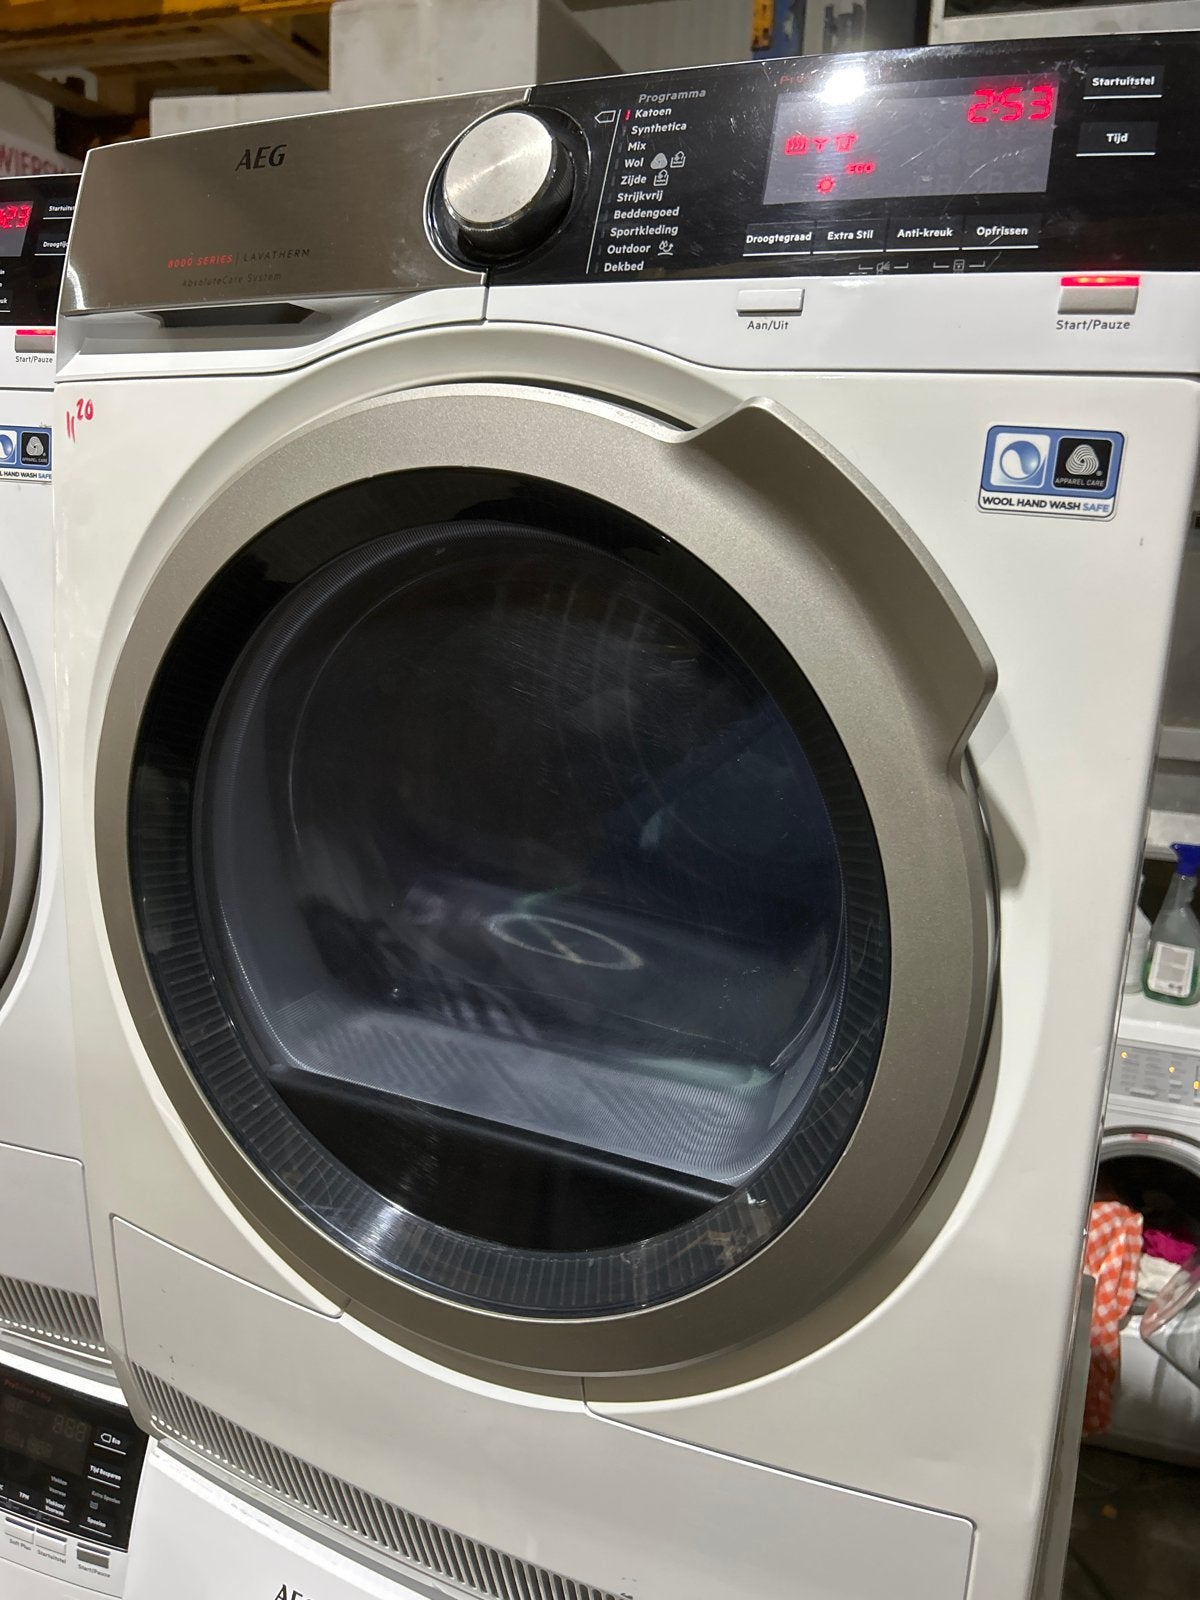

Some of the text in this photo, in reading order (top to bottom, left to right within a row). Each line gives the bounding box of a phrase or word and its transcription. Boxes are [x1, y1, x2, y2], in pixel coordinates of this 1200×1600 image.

[1092, 76, 1155, 87] Startuitstel
[638, 89, 706, 103] Programma
[968, 85, 1056, 124] 2:53
[635, 107, 672, 119] Katoen
[631, 122, 687, 136] Synthetica
[1106, 132, 1129, 144] Tijd
[627, 141, 647, 151] Mix
[234, 144, 287, 171] AEG
[624, 157, 645, 168] Wol
[620, 175, 647, 187] Zijde
[617, 190, 664, 203] Strijkvrij
[613, 206, 680, 220] Beddengoed
[610, 225, 679, 238] Sportkleding
[827, 229, 874, 241] Extra Stil
[897, 227, 953, 239] Anti-kreuk
[976, 225, 1029, 238] Opfrissen
[746, 231, 812, 245] Droogtegraad
[607, 244, 651, 255] Outdoor
[196, 255, 233, 266] SERIES
[244, 249, 310, 262] LAVATHERM
[603, 261, 645, 273] Dekbed
[182, 272, 282, 288] AbsoluteCare System
[747, 319, 789, 332] Aan/Uit
[1056, 319, 1131, 331] Start/Pauze
[15, 355, 53, 364] Start/Pauze
[1055, 477, 1105, 488] APPAREL CARE
[982, 495, 1110, 513] WOOL HAND WASH SAFE
